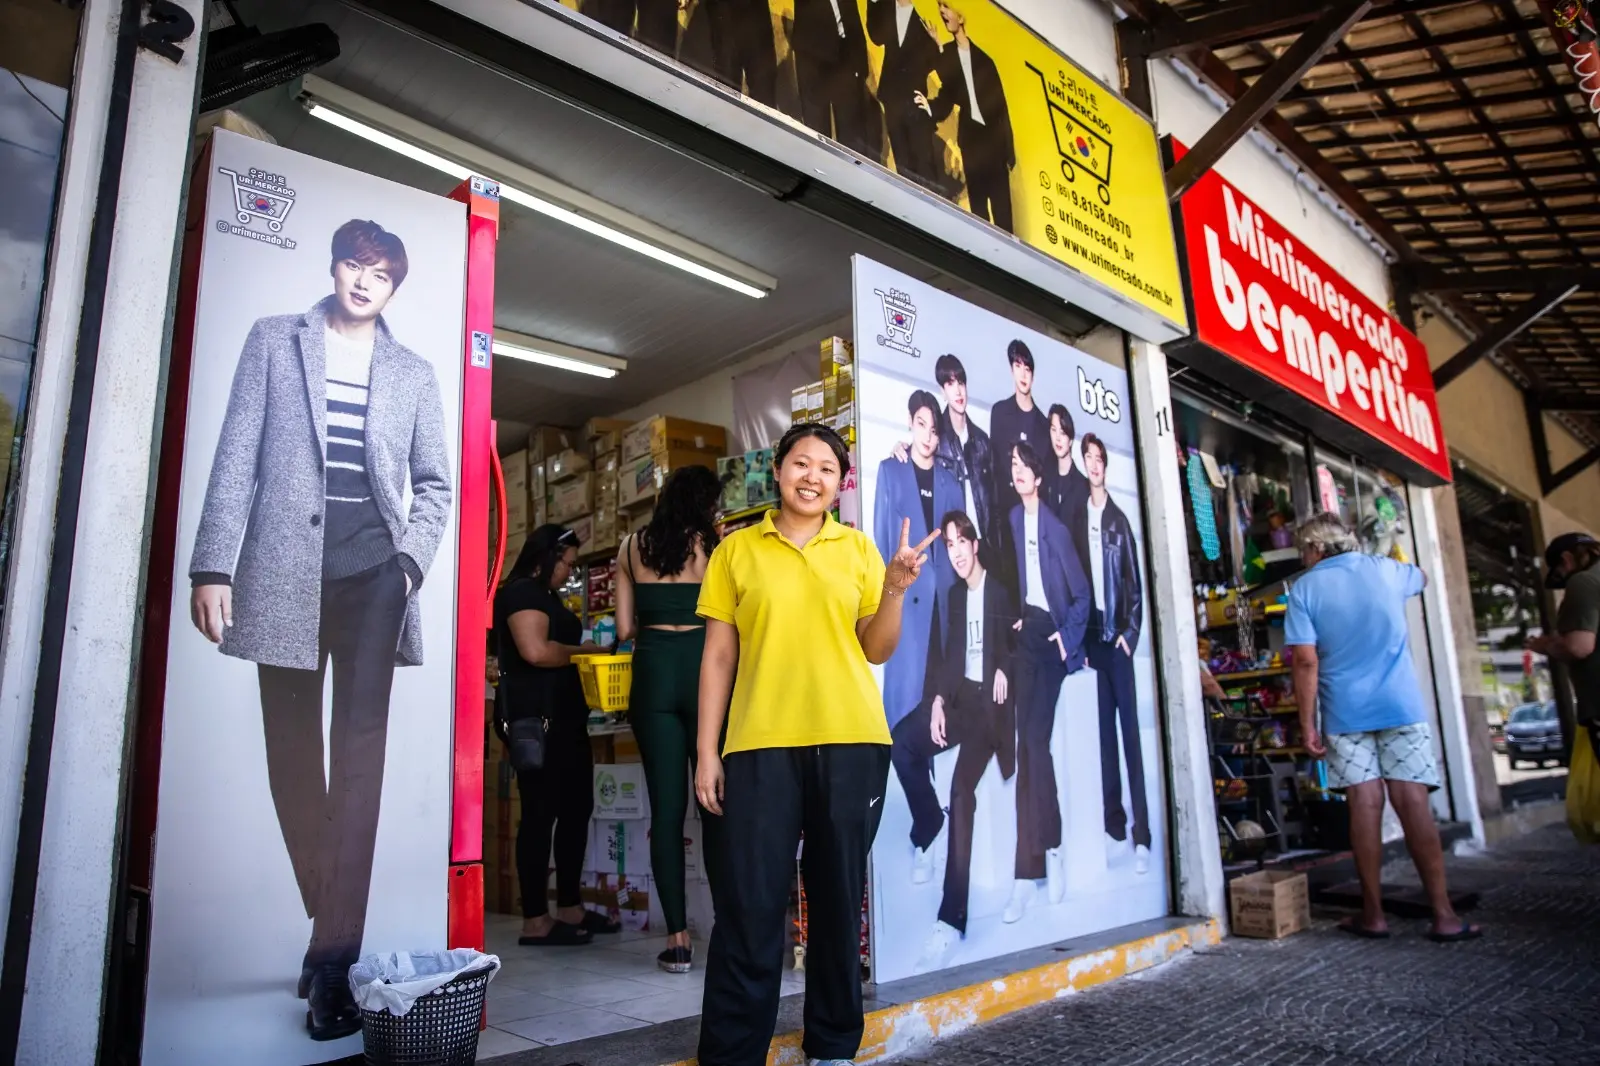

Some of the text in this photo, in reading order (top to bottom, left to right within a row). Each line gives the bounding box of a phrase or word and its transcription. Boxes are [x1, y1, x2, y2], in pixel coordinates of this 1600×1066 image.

[1048, 81, 1112, 135] URI MERCADO
[1058, 70, 1099, 111] 우리마트
[238, 175, 295, 197] URI MERCADO
[249, 168, 286, 185] 우리마트
[230, 225, 297, 249] urimercado_br
[1061, 235, 1173, 307] www.urimercado.com.br
[1221, 184, 1408, 371] Minimercado
[1203, 223, 1439, 455] bempertim
[1077, 365, 1121, 424] bts
